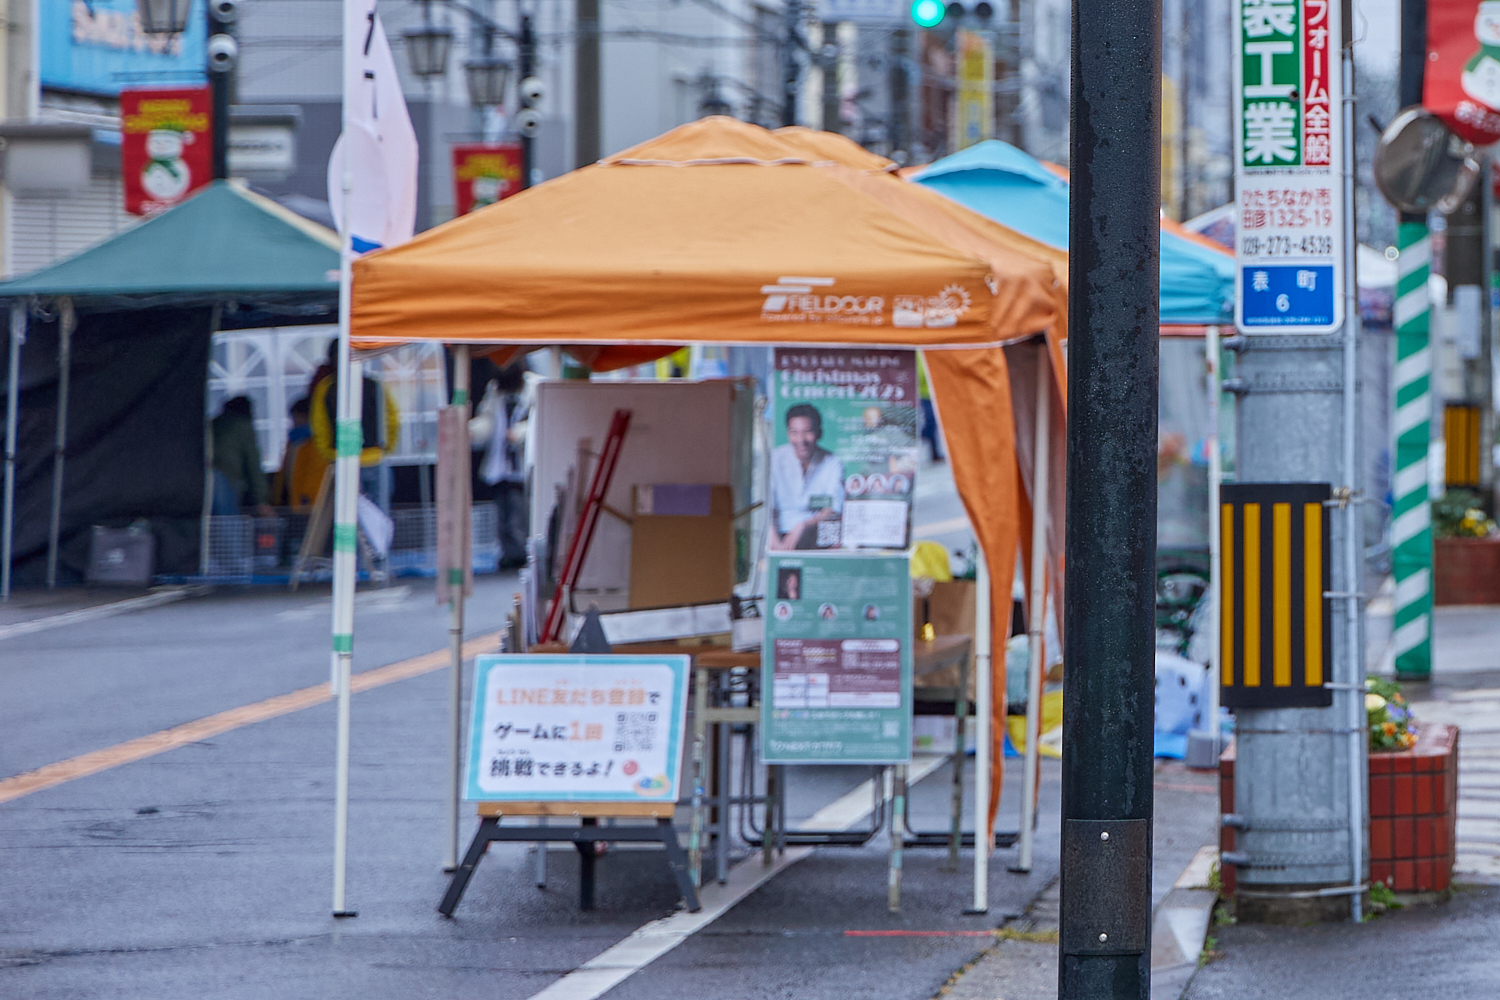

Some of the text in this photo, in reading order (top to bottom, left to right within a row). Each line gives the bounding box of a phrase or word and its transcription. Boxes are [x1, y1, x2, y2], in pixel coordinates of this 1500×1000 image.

[1275, 293, 1290, 313] 6
[781, 368, 881, 384] Christmas
[494, 720, 605, 742] ゲームに1回
